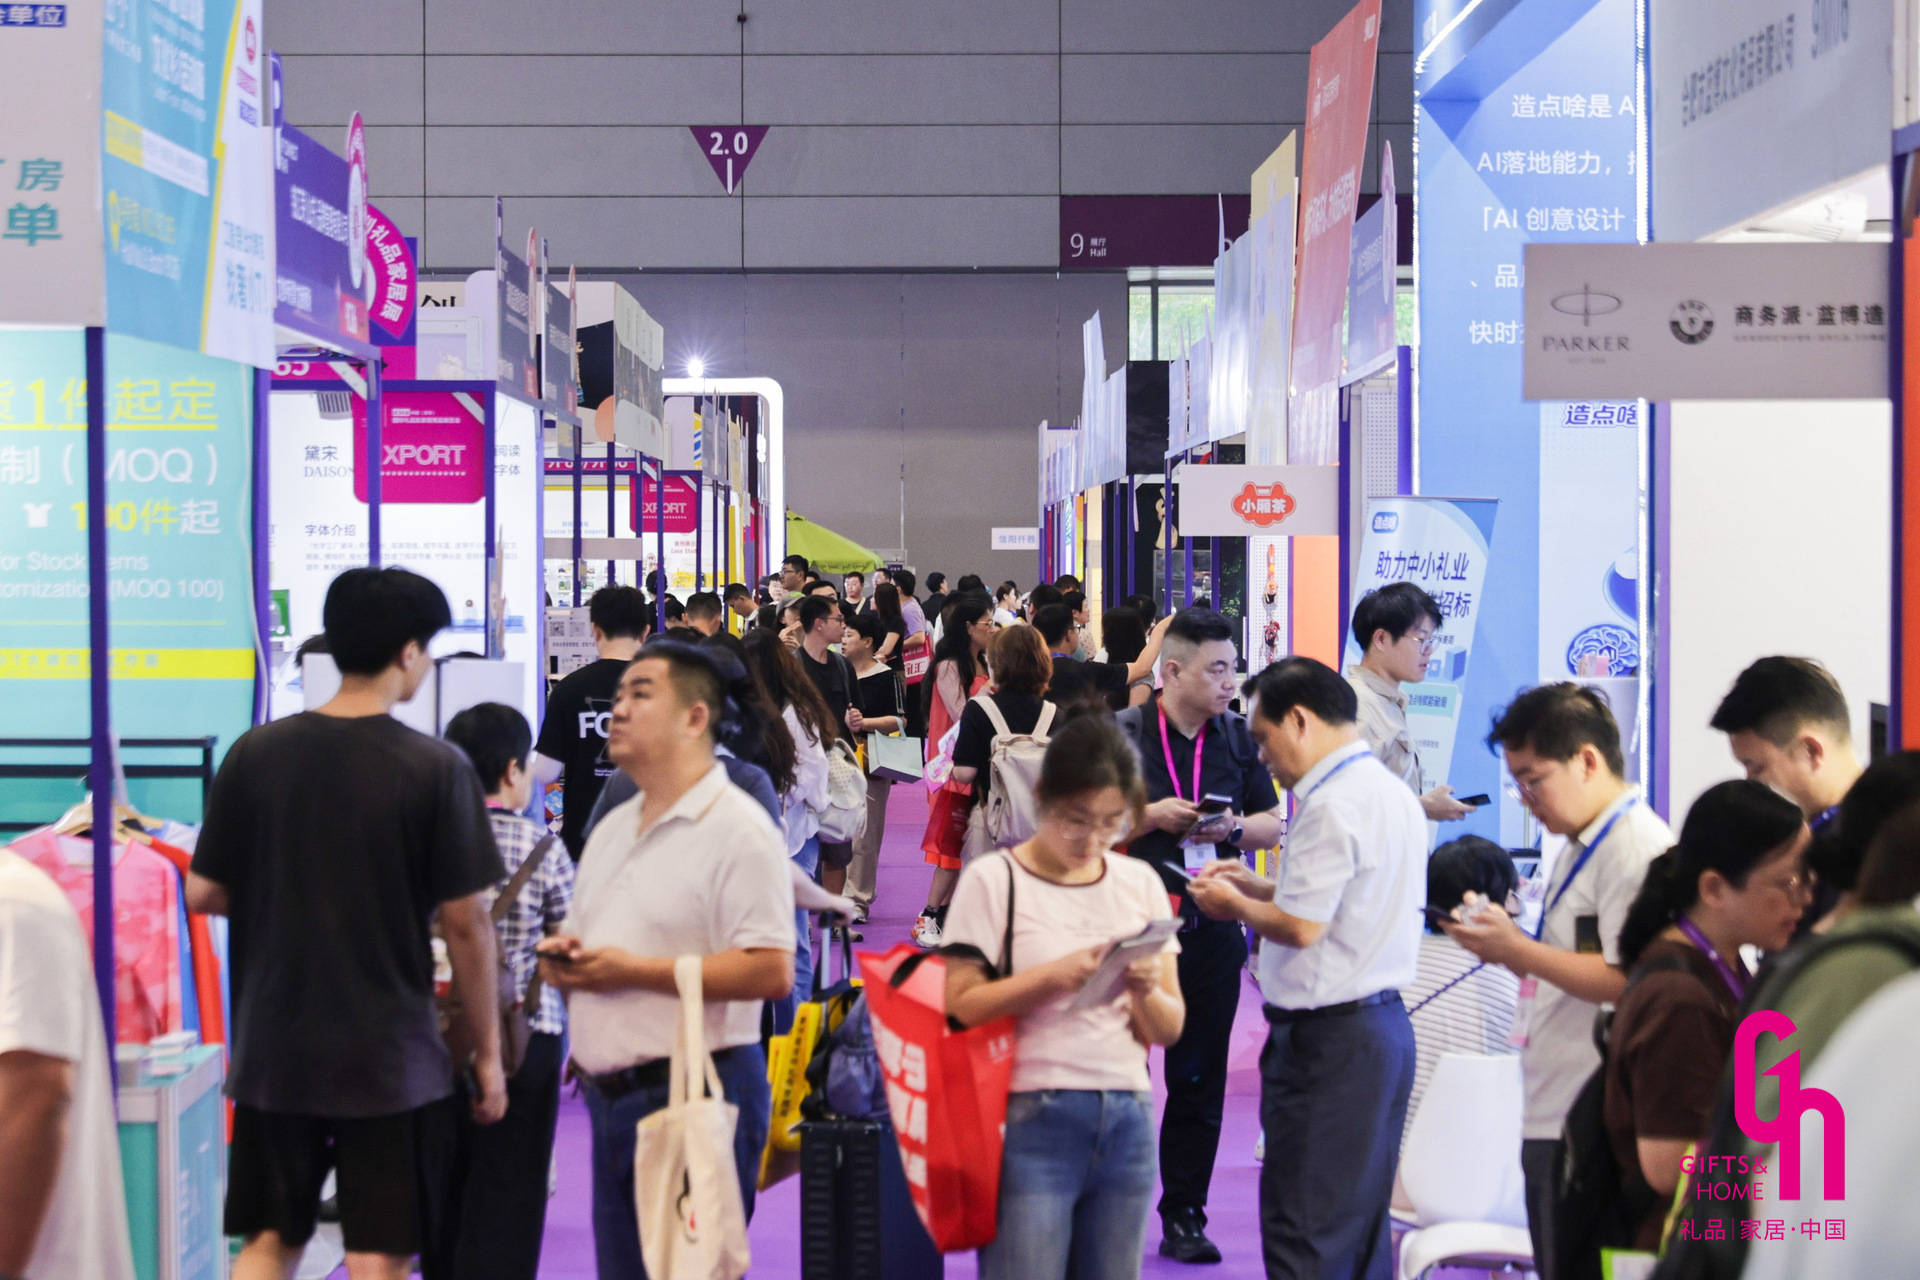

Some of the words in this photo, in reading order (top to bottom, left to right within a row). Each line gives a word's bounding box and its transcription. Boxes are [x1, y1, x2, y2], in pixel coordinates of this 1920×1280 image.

[1512, 95, 1612, 118] 造点啥是
[710, 131, 749, 155] 2.0
[0, 158, 63, 191] 房
[3, 203, 63, 246] 单
[1525, 207, 1625, 231] 创意设计
[1070, 233, 1085, 258] 9
[1090, 248, 1107, 257] Hall
[1468, 320, 1524, 344] 快时
[1543, 336, 1630, 352] PARKER
[382, 444, 467, 466] XPORT
[72, 498, 222, 535] 10件起
[641, 502, 688, 514] XORT
[28, 551, 88, 570] Stock
[107, 554, 150, 571] ems
[177, 578, 225, 602] 100)
[1428, 590, 1473, 619] 招标
